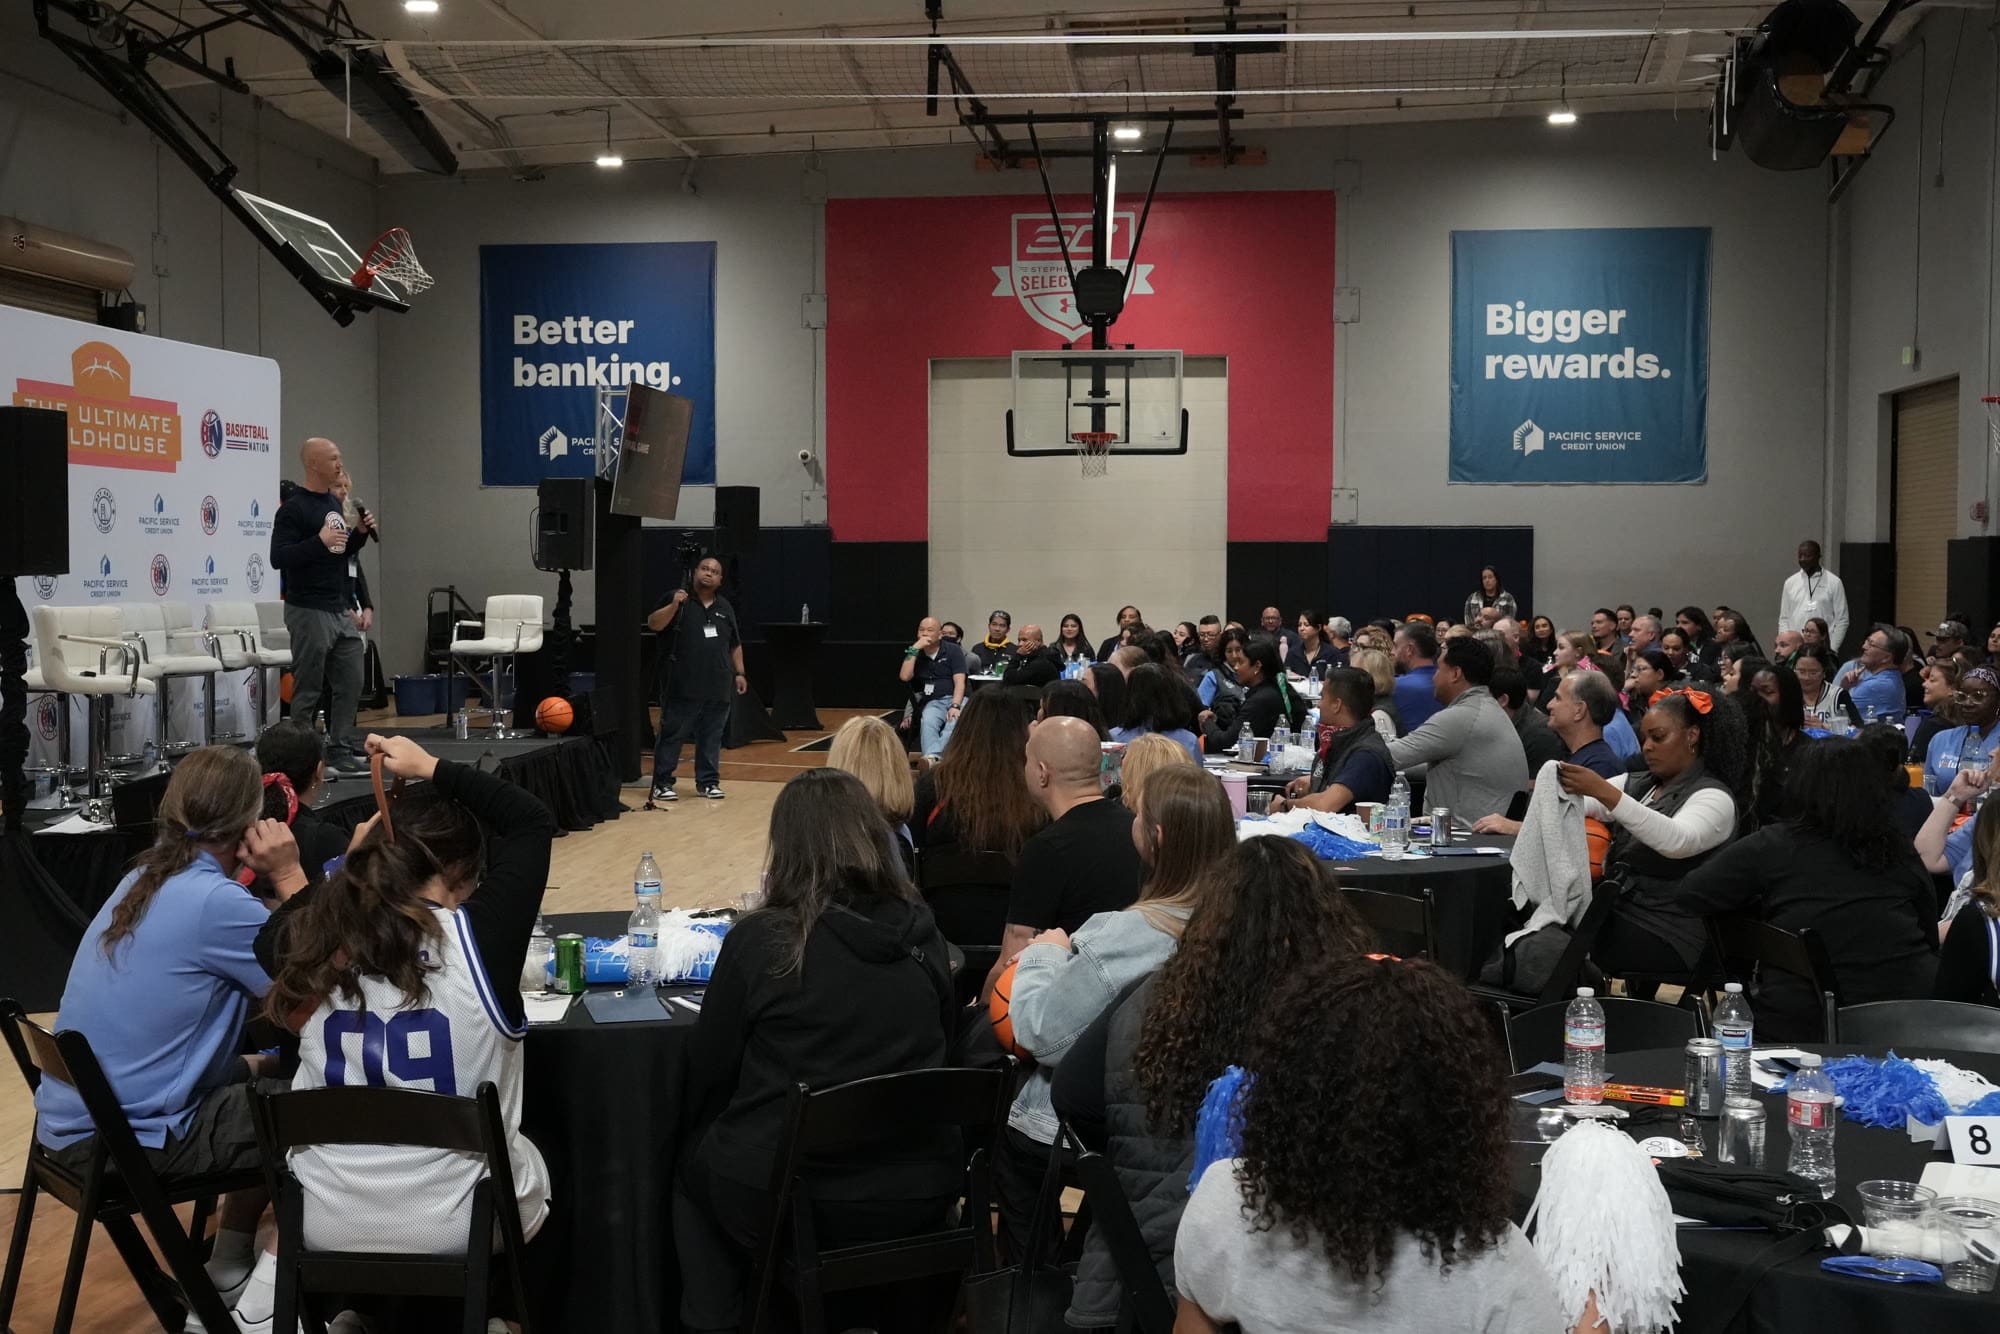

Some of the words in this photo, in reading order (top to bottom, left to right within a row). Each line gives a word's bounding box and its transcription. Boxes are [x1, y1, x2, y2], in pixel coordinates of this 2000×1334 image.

[1021, 275, 1072, 291] SELEC
[513, 314, 634, 345] Better
[1486, 301, 1626, 343] Bigger
[513, 353, 681, 392] banking.
[1485, 347, 1671, 379] rewards.
[79, 405, 172, 434] ULTIMATE
[225, 423, 269, 440] BASKETBALL
[70, 427, 167, 454] LDHOUSE
[249, 442, 269, 452] NATION
[1548, 432, 1592, 440] PACIFIC
[1595, 432, 1641, 440] SERVICE
[1968, 1124, 1991, 1155] 8
